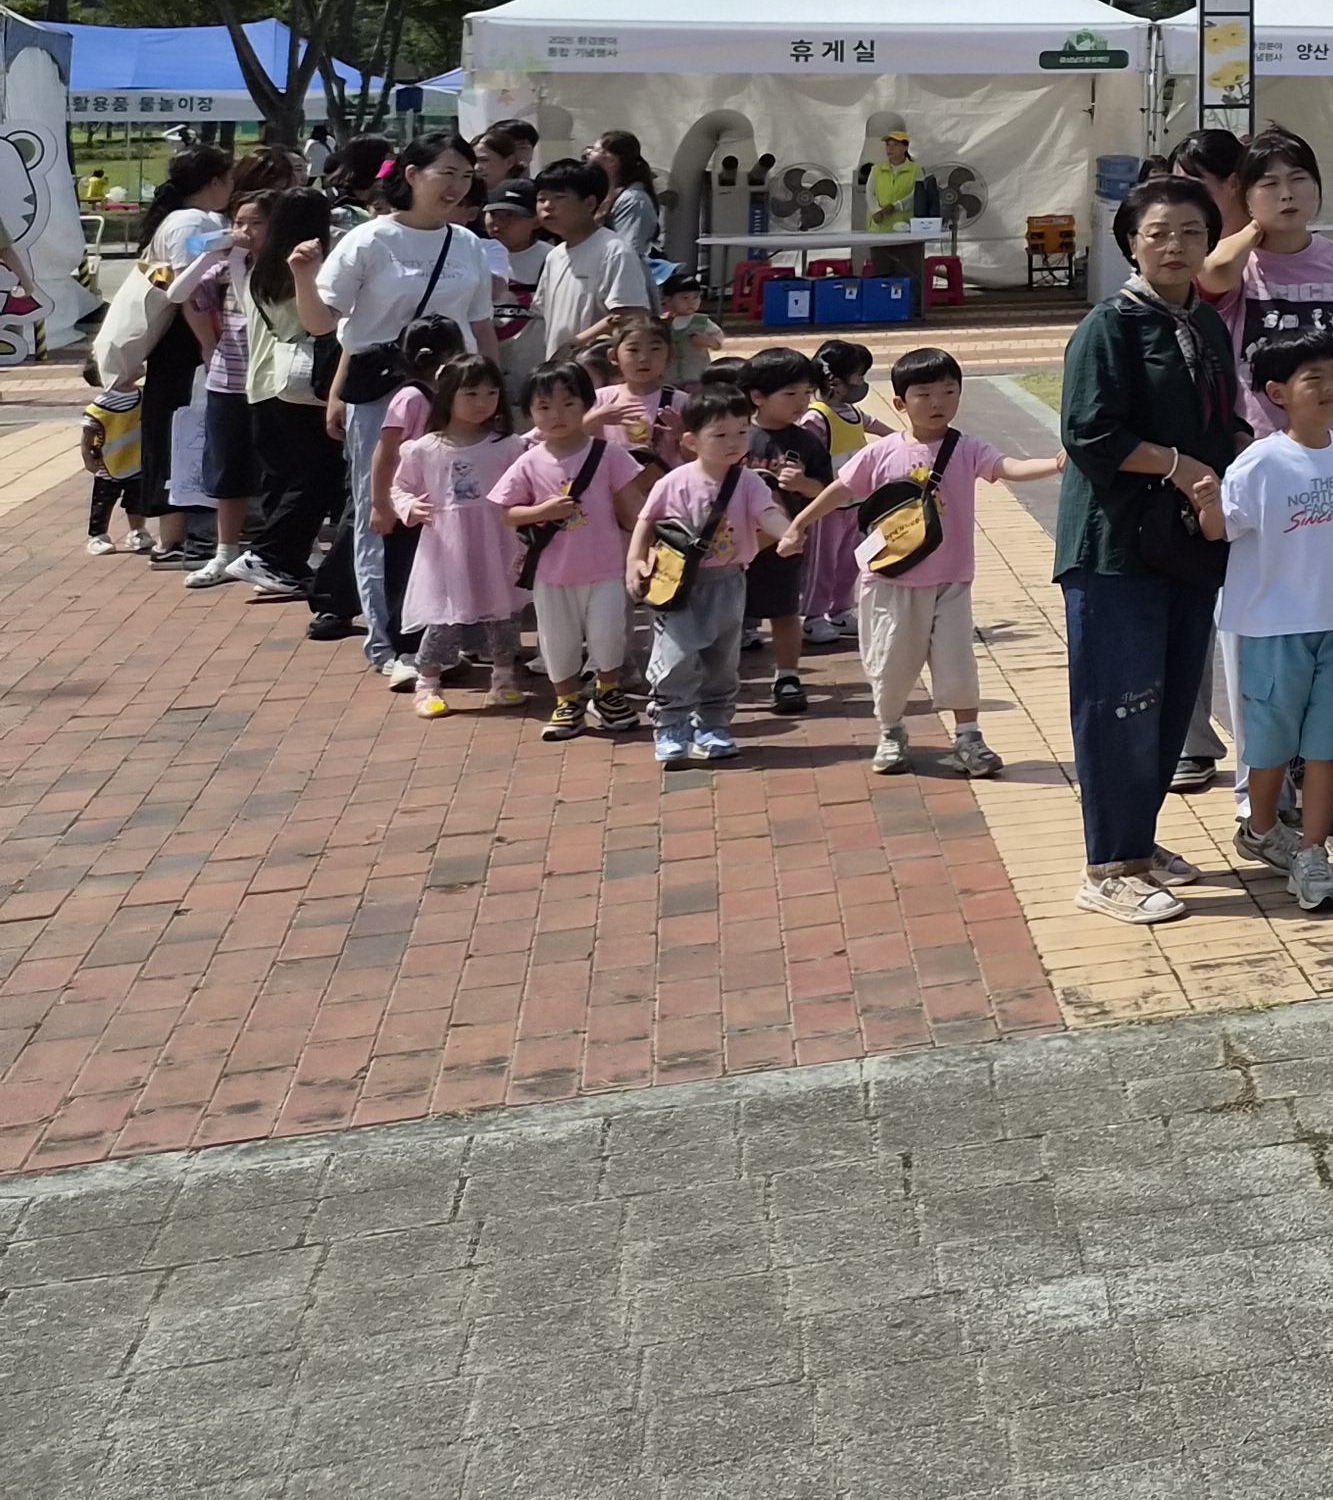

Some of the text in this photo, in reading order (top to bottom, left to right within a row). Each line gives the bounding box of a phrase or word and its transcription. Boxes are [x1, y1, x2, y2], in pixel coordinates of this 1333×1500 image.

[575, 48, 619, 58] 기념행사
[789, 38, 877, 64] 휴게실
[1296, 43, 1330, 61] 양산
[139, 96, 214, 112] 물놀이장
